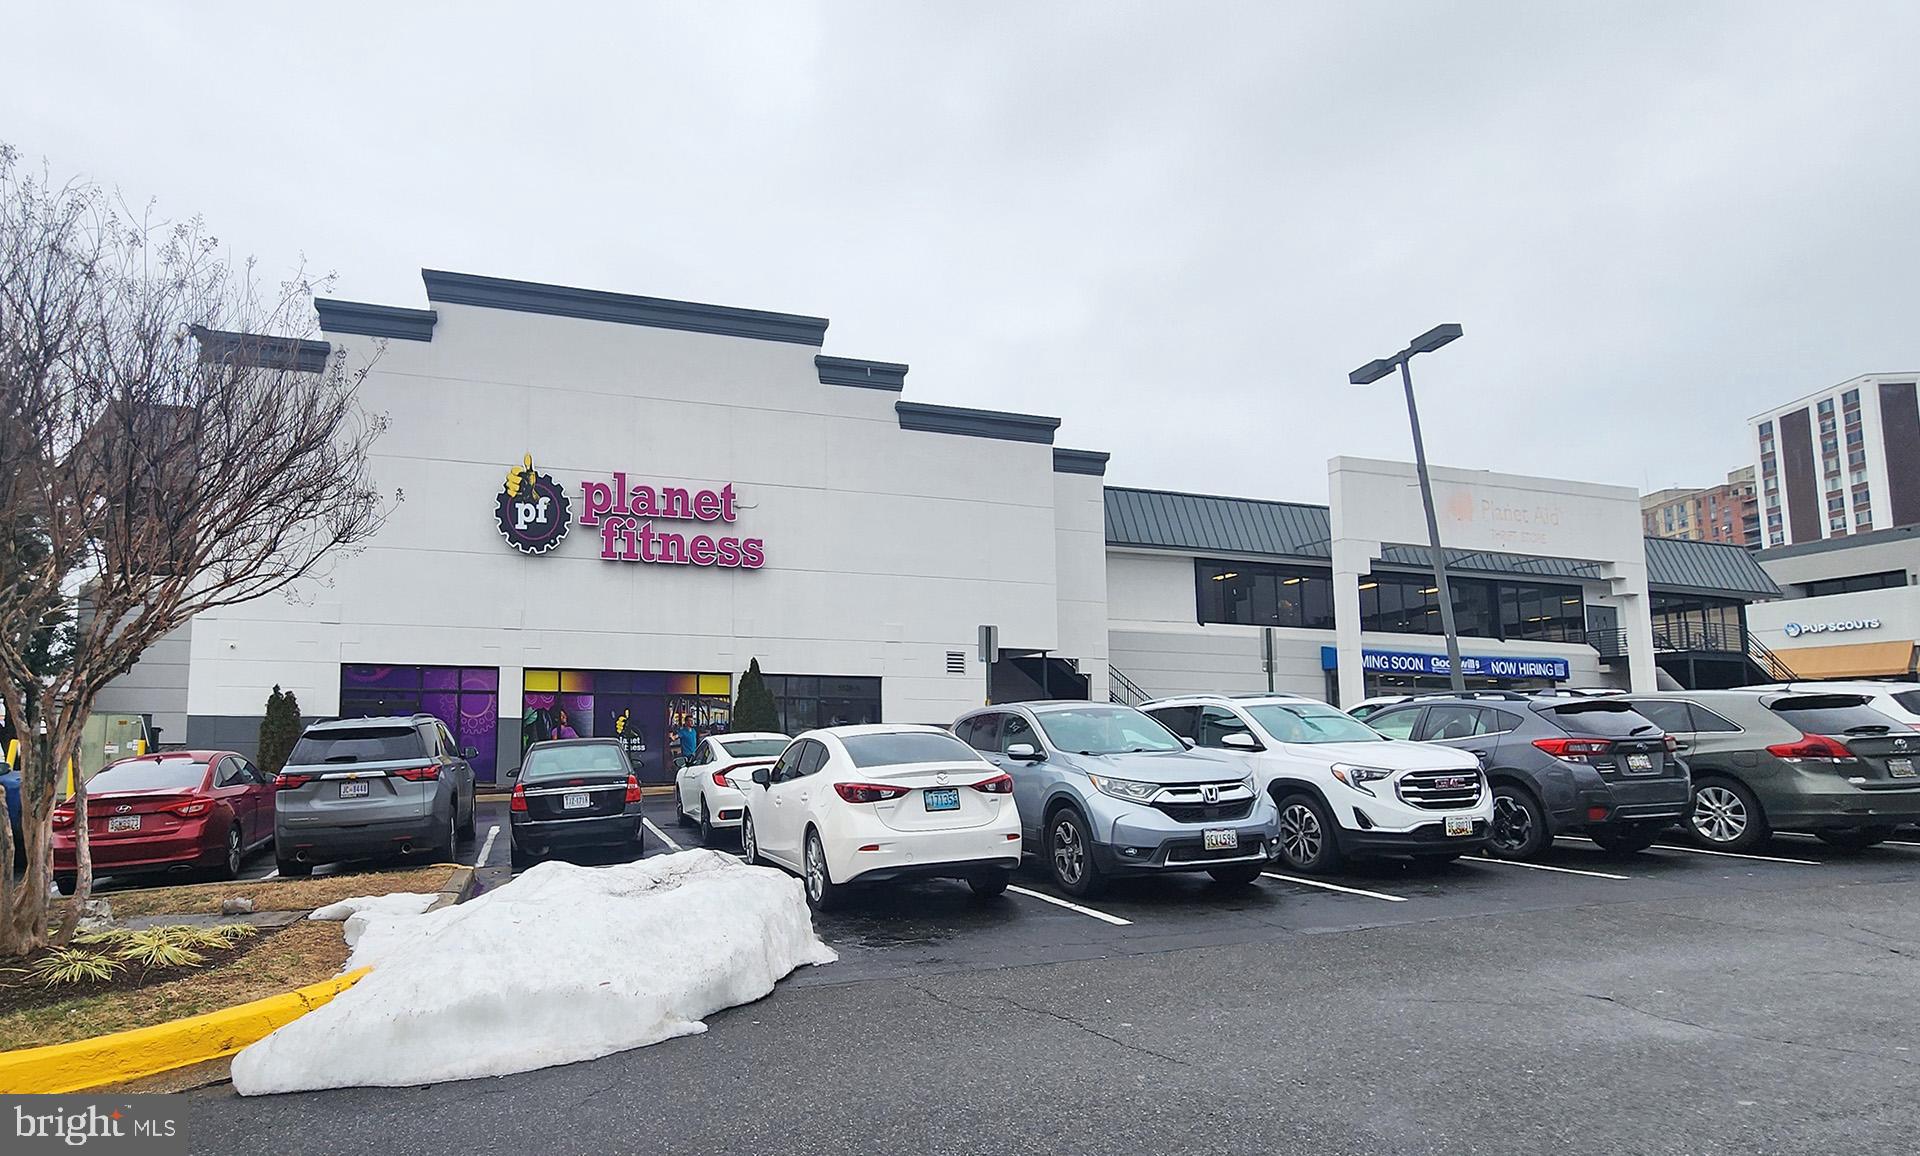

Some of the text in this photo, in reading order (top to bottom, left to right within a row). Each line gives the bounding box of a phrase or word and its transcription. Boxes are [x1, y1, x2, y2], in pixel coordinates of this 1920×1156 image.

[579, 471, 738, 526] planet
[514, 497, 551, 530] pf
[600, 516, 766, 569] fitness
[1801, 618, 1880, 634] PUP SCOUTS
[1362, 655, 1424, 671] MING SOON
[1491, 661, 1554, 676] NOW HIRING
